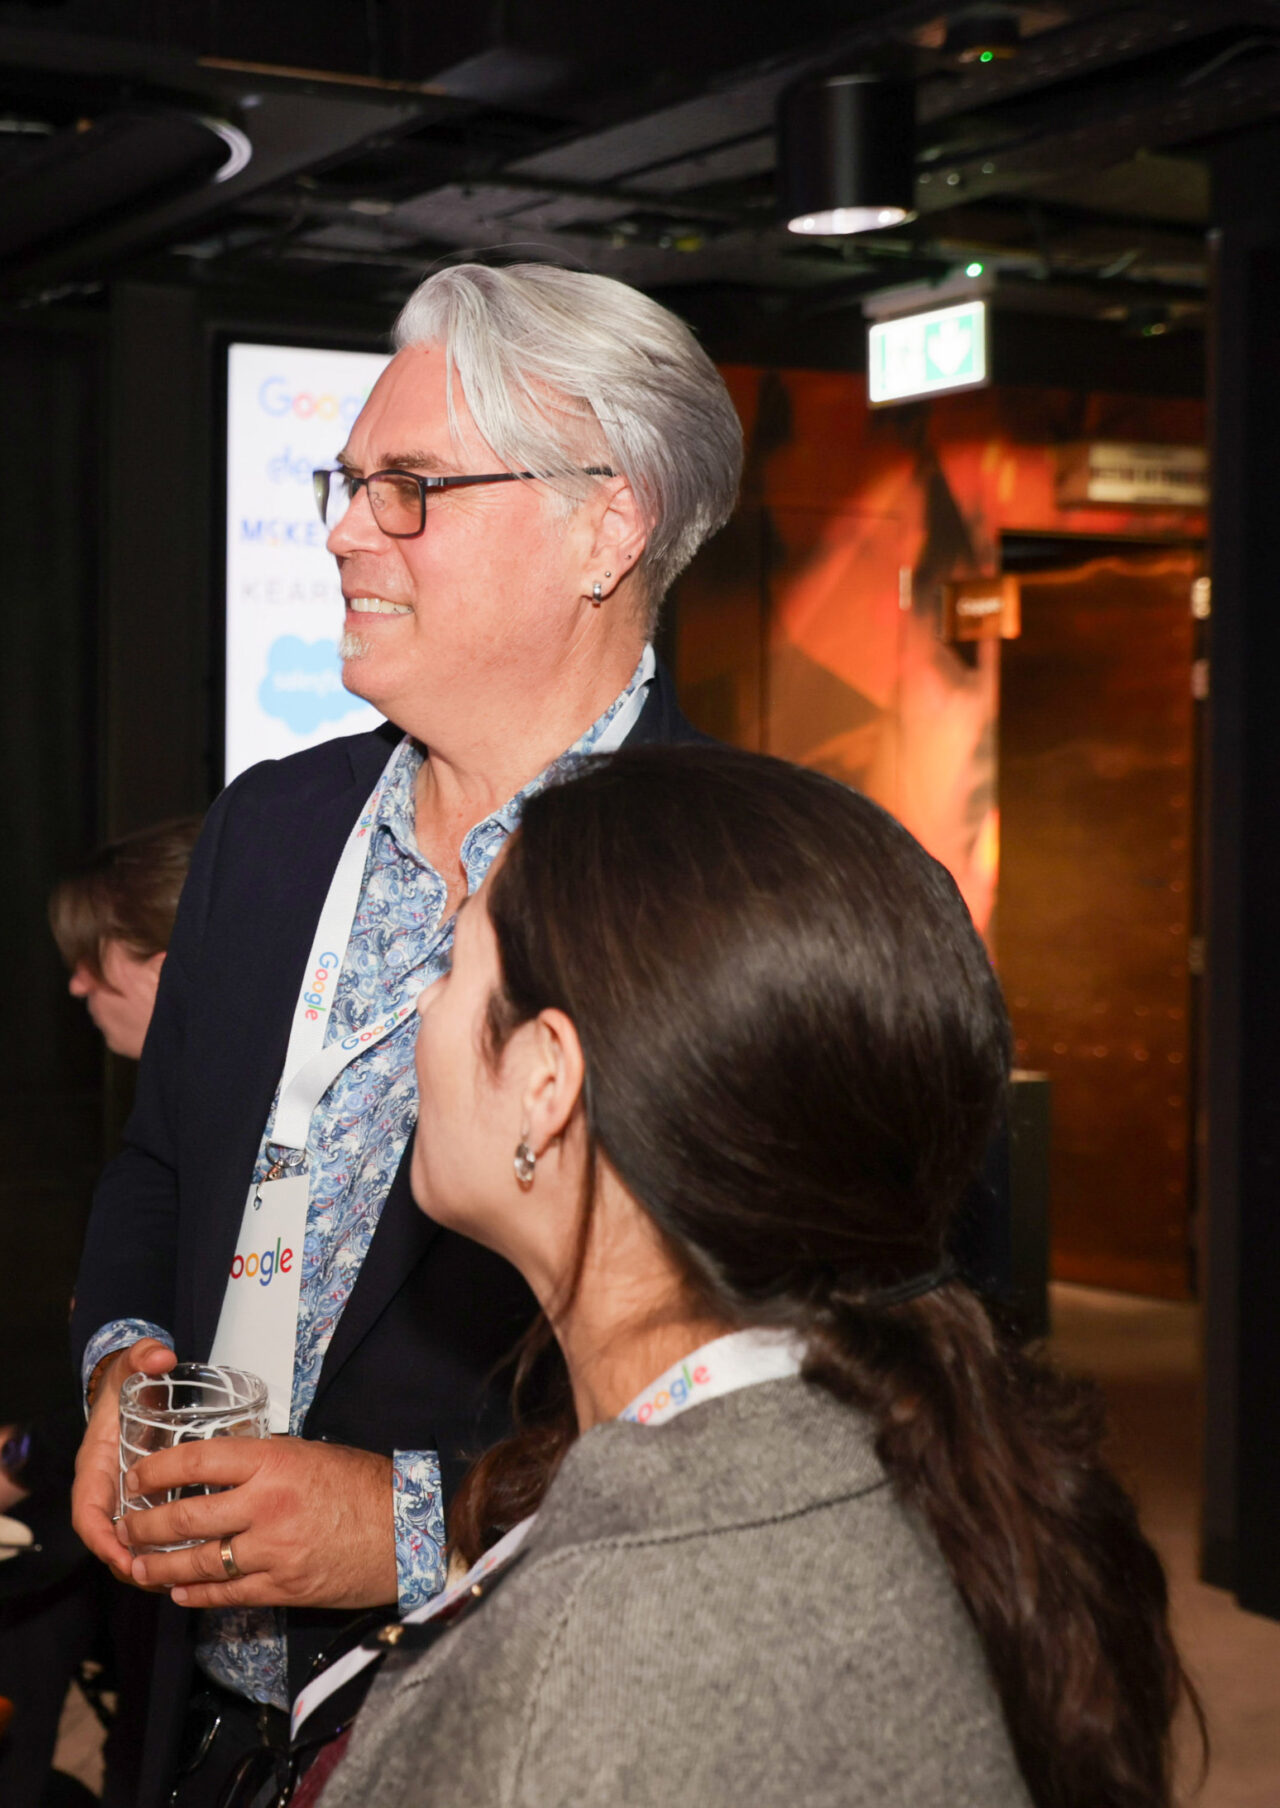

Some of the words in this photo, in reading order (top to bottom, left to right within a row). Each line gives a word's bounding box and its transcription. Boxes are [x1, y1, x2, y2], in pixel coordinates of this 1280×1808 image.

[258, 374, 369, 432] Goog
[240, 577, 341, 605] KEAR
[304, 951, 339, 1021] Google
[341, 1007, 409, 1050] Google
[229, 1236, 293, 1287] oogle
